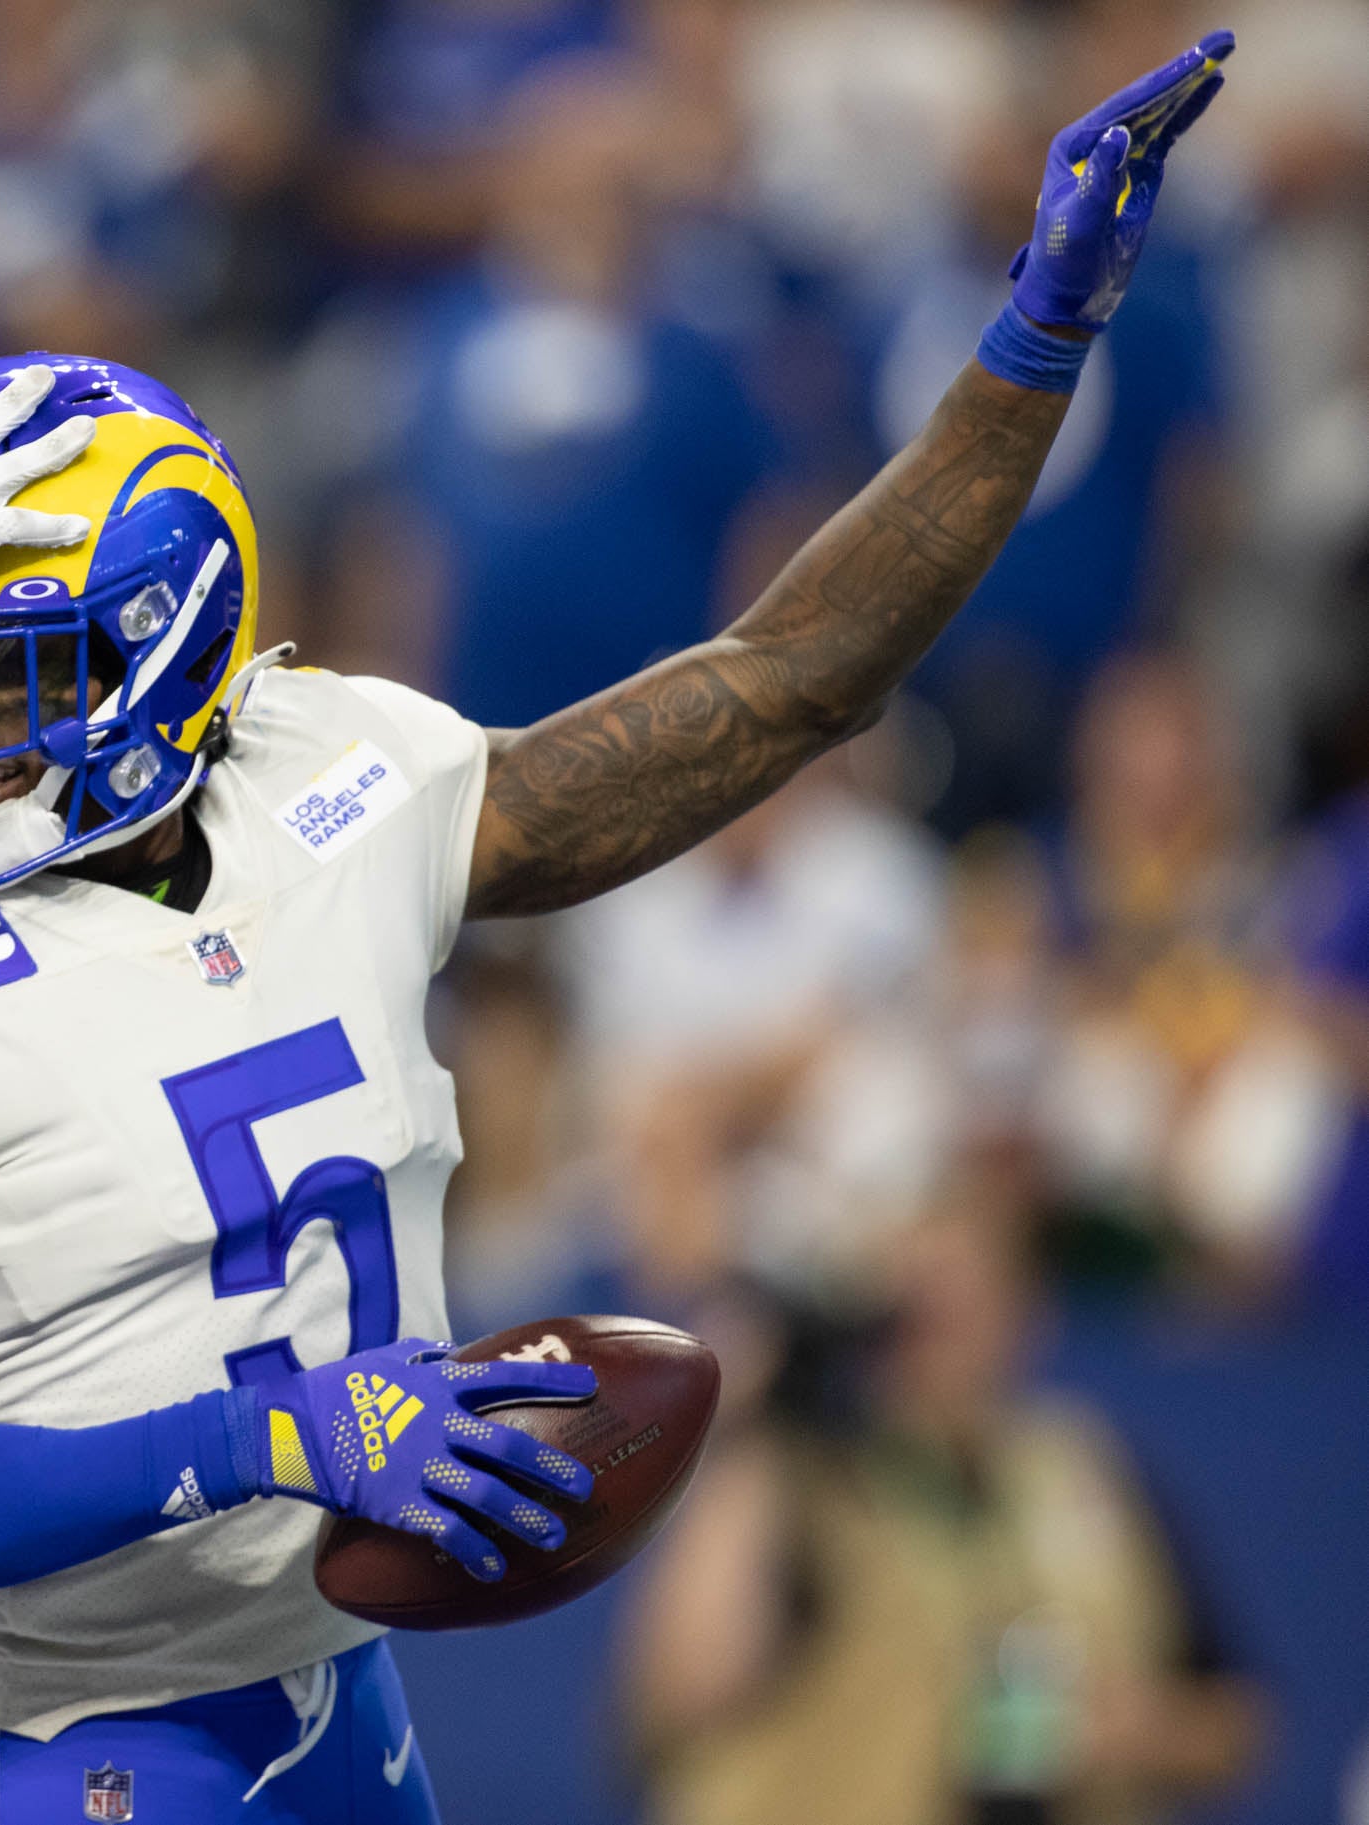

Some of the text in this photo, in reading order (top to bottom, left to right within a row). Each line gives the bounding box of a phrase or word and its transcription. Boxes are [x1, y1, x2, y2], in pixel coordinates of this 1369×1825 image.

[284, 793, 325, 827] LOS
[299, 763, 387, 838] ANGELES
[309, 801, 366, 848] RAMS
[202, 949, 241, 977] NFL
[160, 1016, 400, 1389] 5
[346, 1372, 387, 1472] adidas
[608, 1423, 663, 1467] LEAGUE
[92, 1792, 127, 1817] NFL
